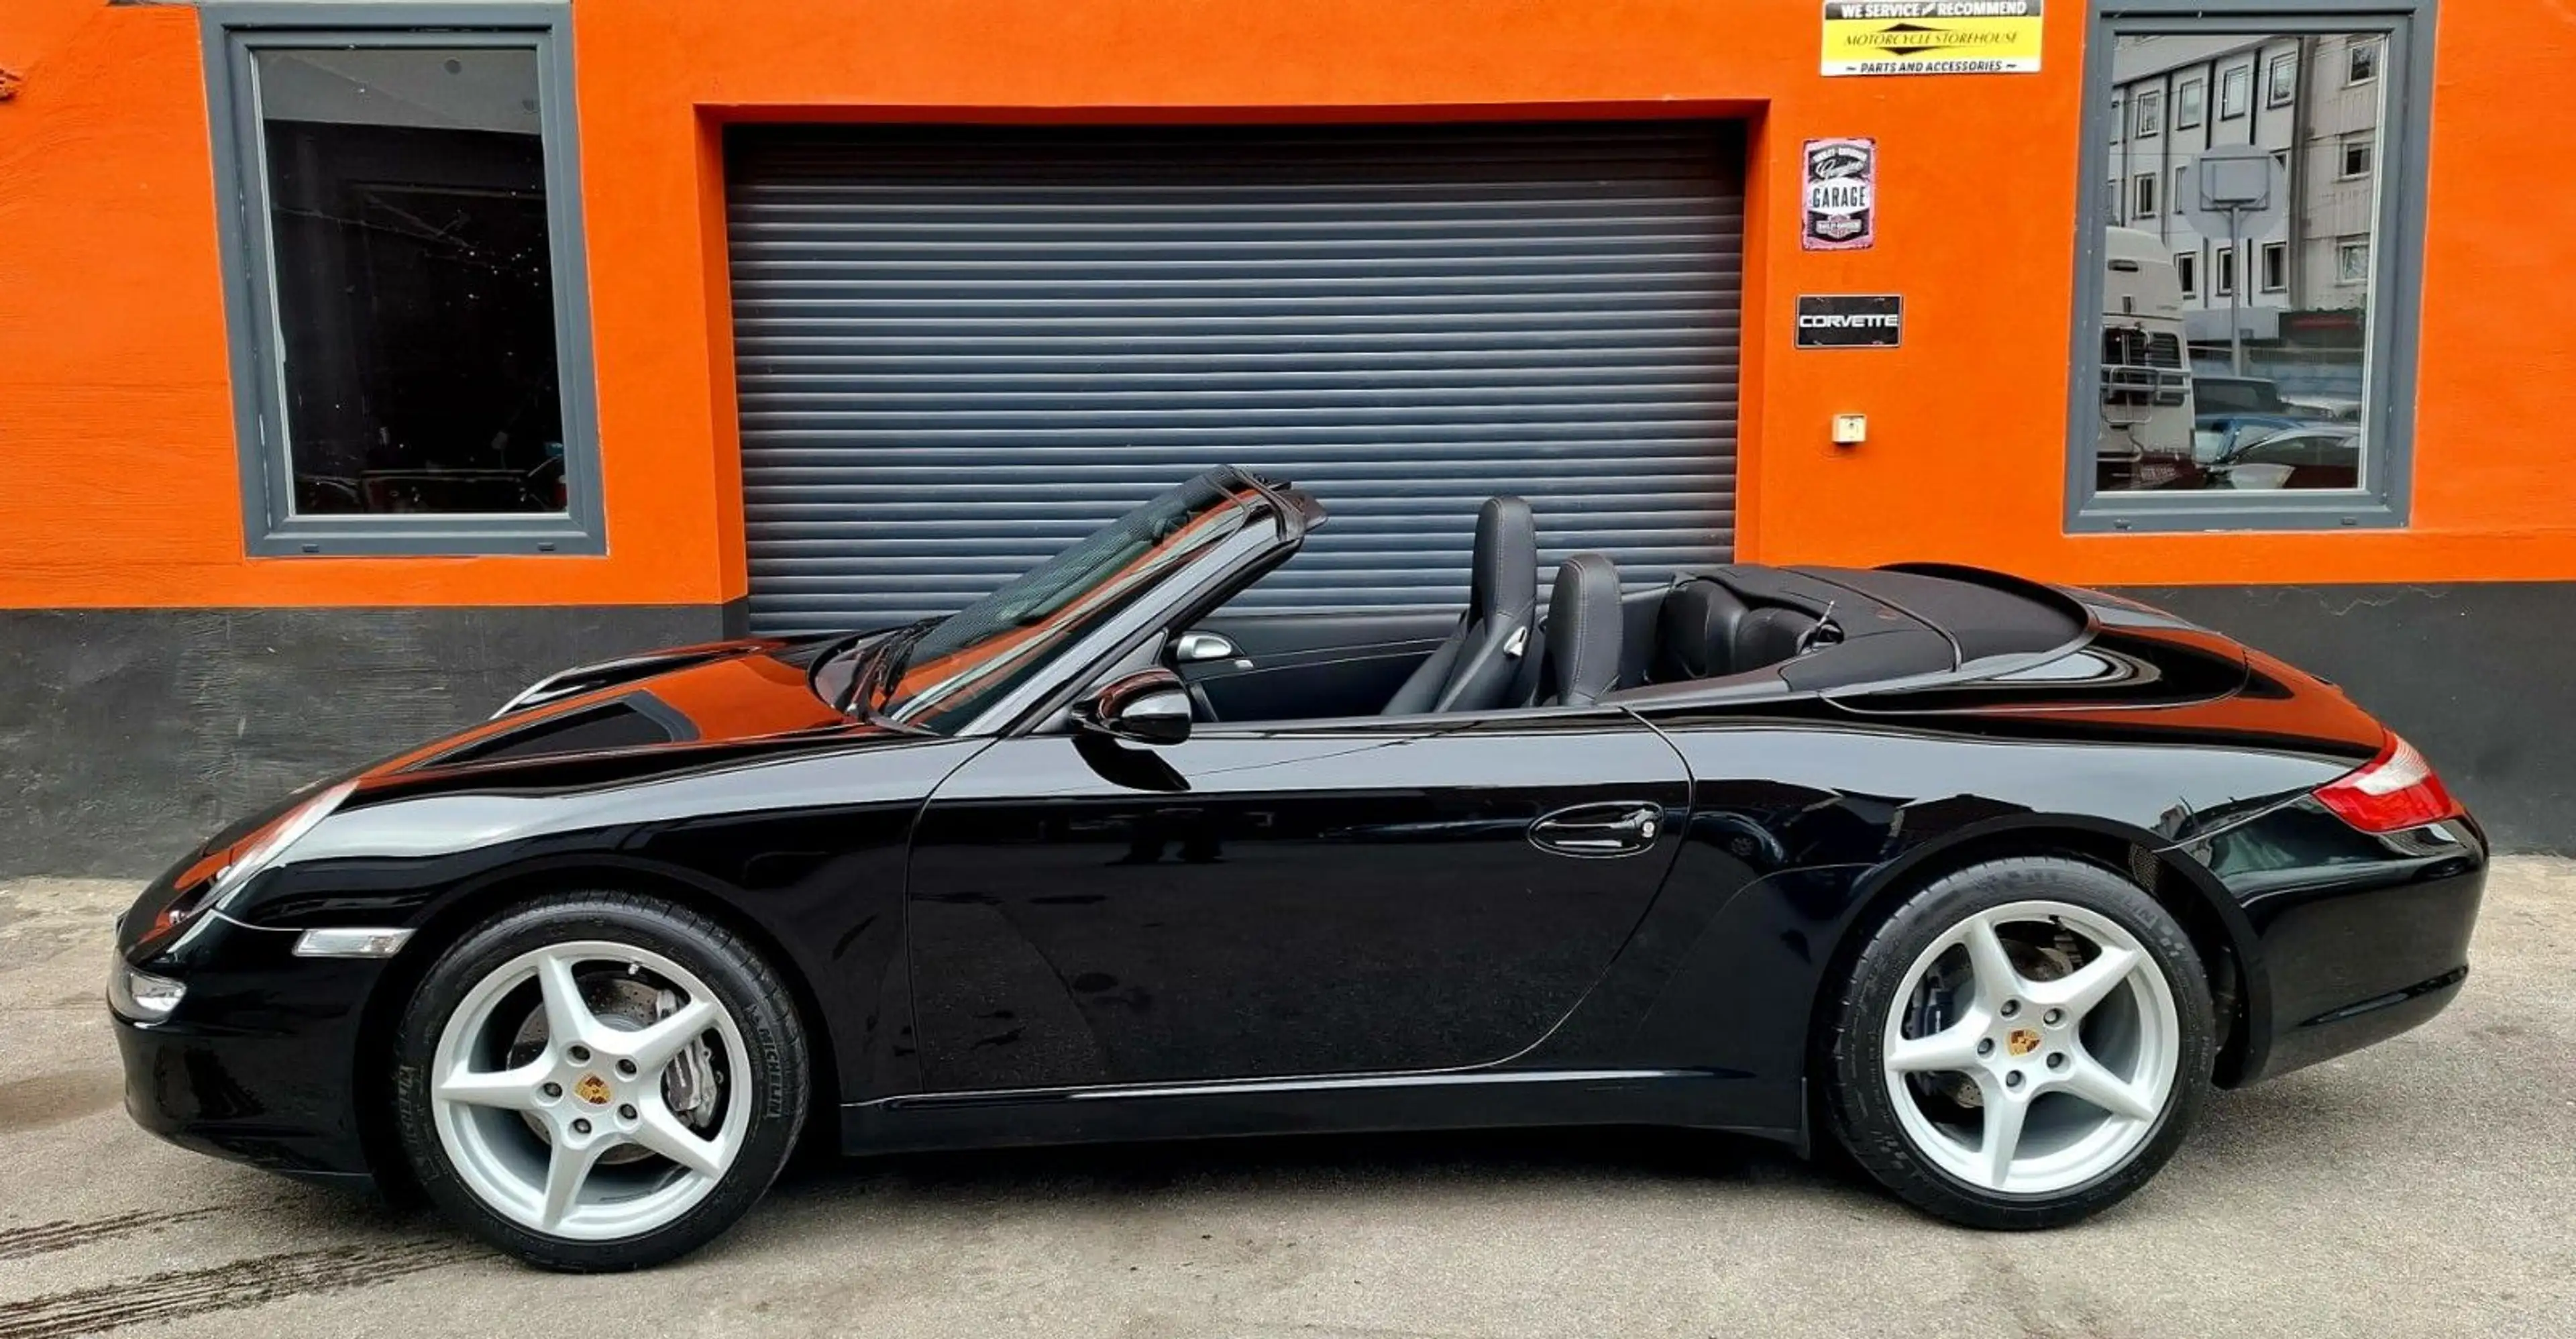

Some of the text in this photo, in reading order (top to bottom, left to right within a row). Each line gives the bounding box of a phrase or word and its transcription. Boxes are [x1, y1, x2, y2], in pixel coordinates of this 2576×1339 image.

[1841, 4, 1863, 18] WE
[1865, 3, 1920, 17] SERVICE
[1937, 1, 2027, 16] RECOMMEND
[1845, 31, 2017, 46] MOTORCYCLE STOREHOUSE
[1860, 60, 2002, 73] PARTS AND ACCESSORIES
[1813, 186, 1866, 208] GARAGE
[1799, 314, 1898, 328] CORVETTE
[758, 1026, 783, 1118] MICHELIN
